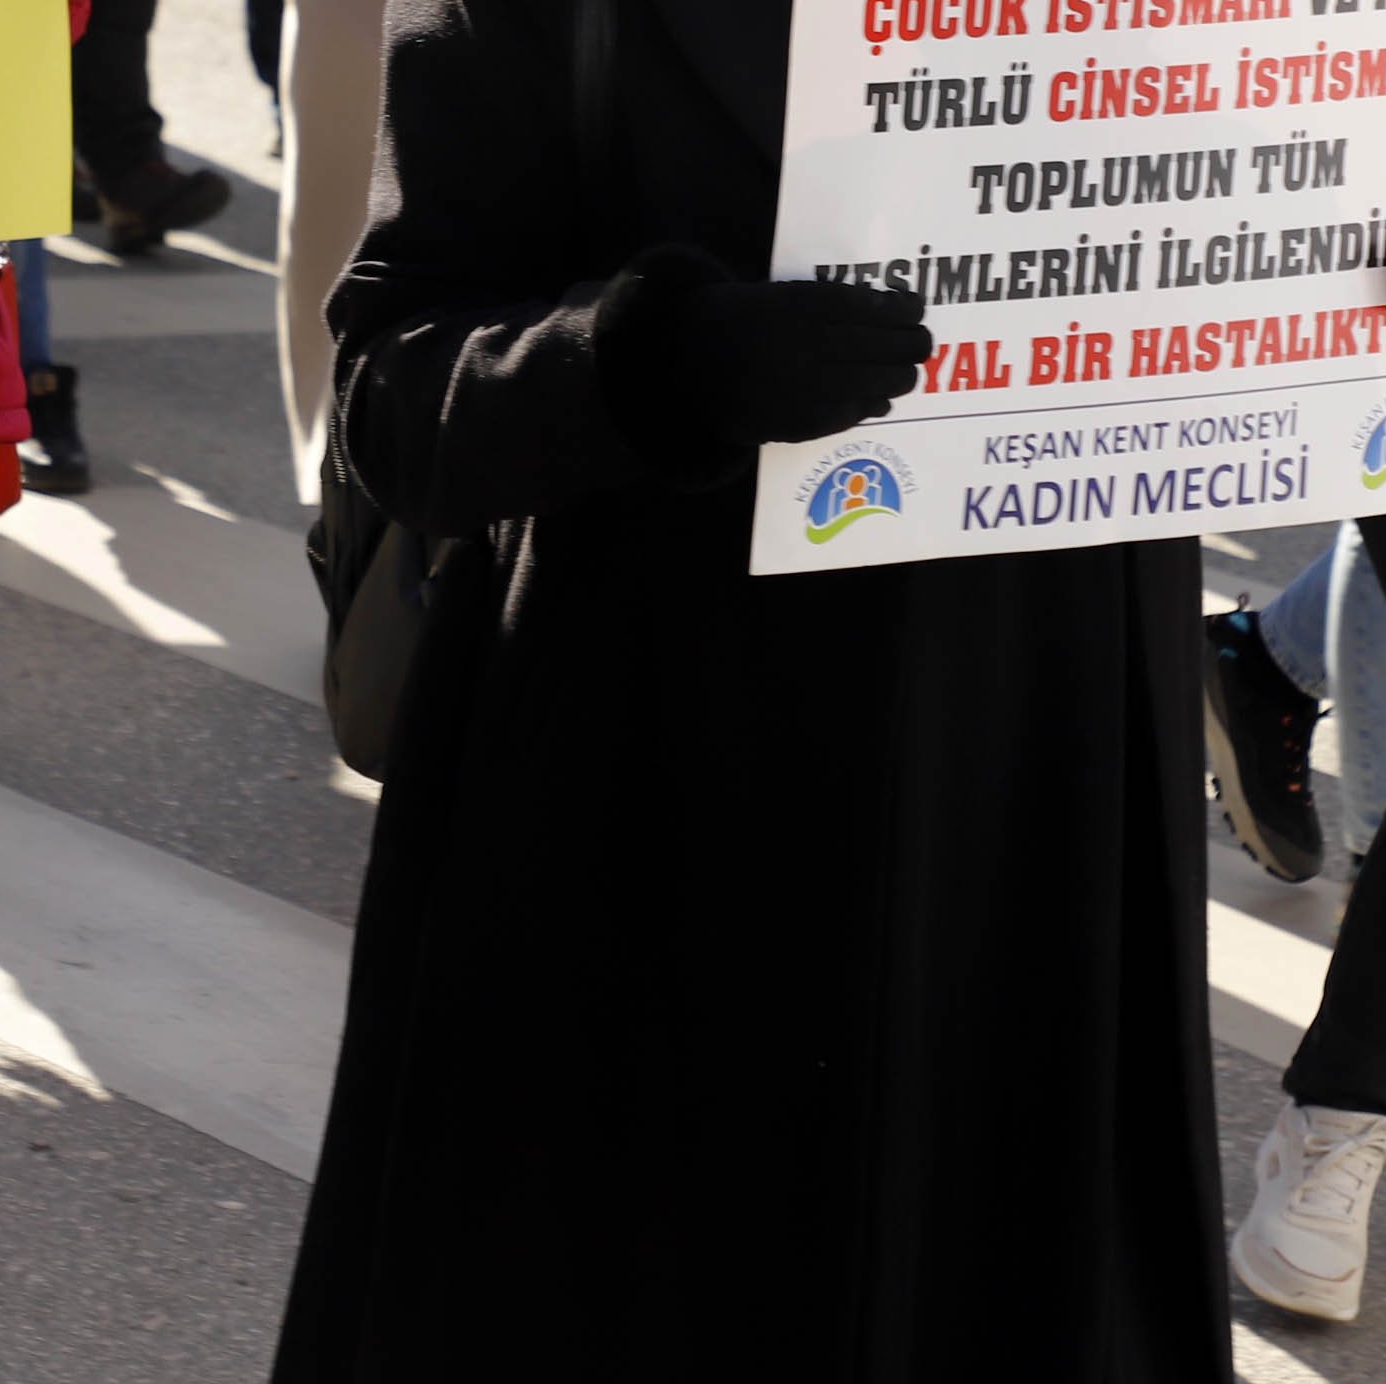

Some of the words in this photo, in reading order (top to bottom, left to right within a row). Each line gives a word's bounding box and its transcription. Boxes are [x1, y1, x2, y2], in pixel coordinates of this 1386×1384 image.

[865, 62, 1033, 133] TÜRLÜ
[1048, 57, 1220, 123] CİNSEL
[970, 148, 1238, 215] TOPLUMUN
[1250, 129, 1349, 194] TÜM
[1027, 320, 1113, 386] BİR
[984, 429, 1084, 469] KEŞAN
[1093, 422, 1170, 456] KENT
[1177, 401, 1300, 448] KONSEYİ
[962, 475, 1116, 531] KADIN
[1131, 444, 1311, 516] MECLİSİ
